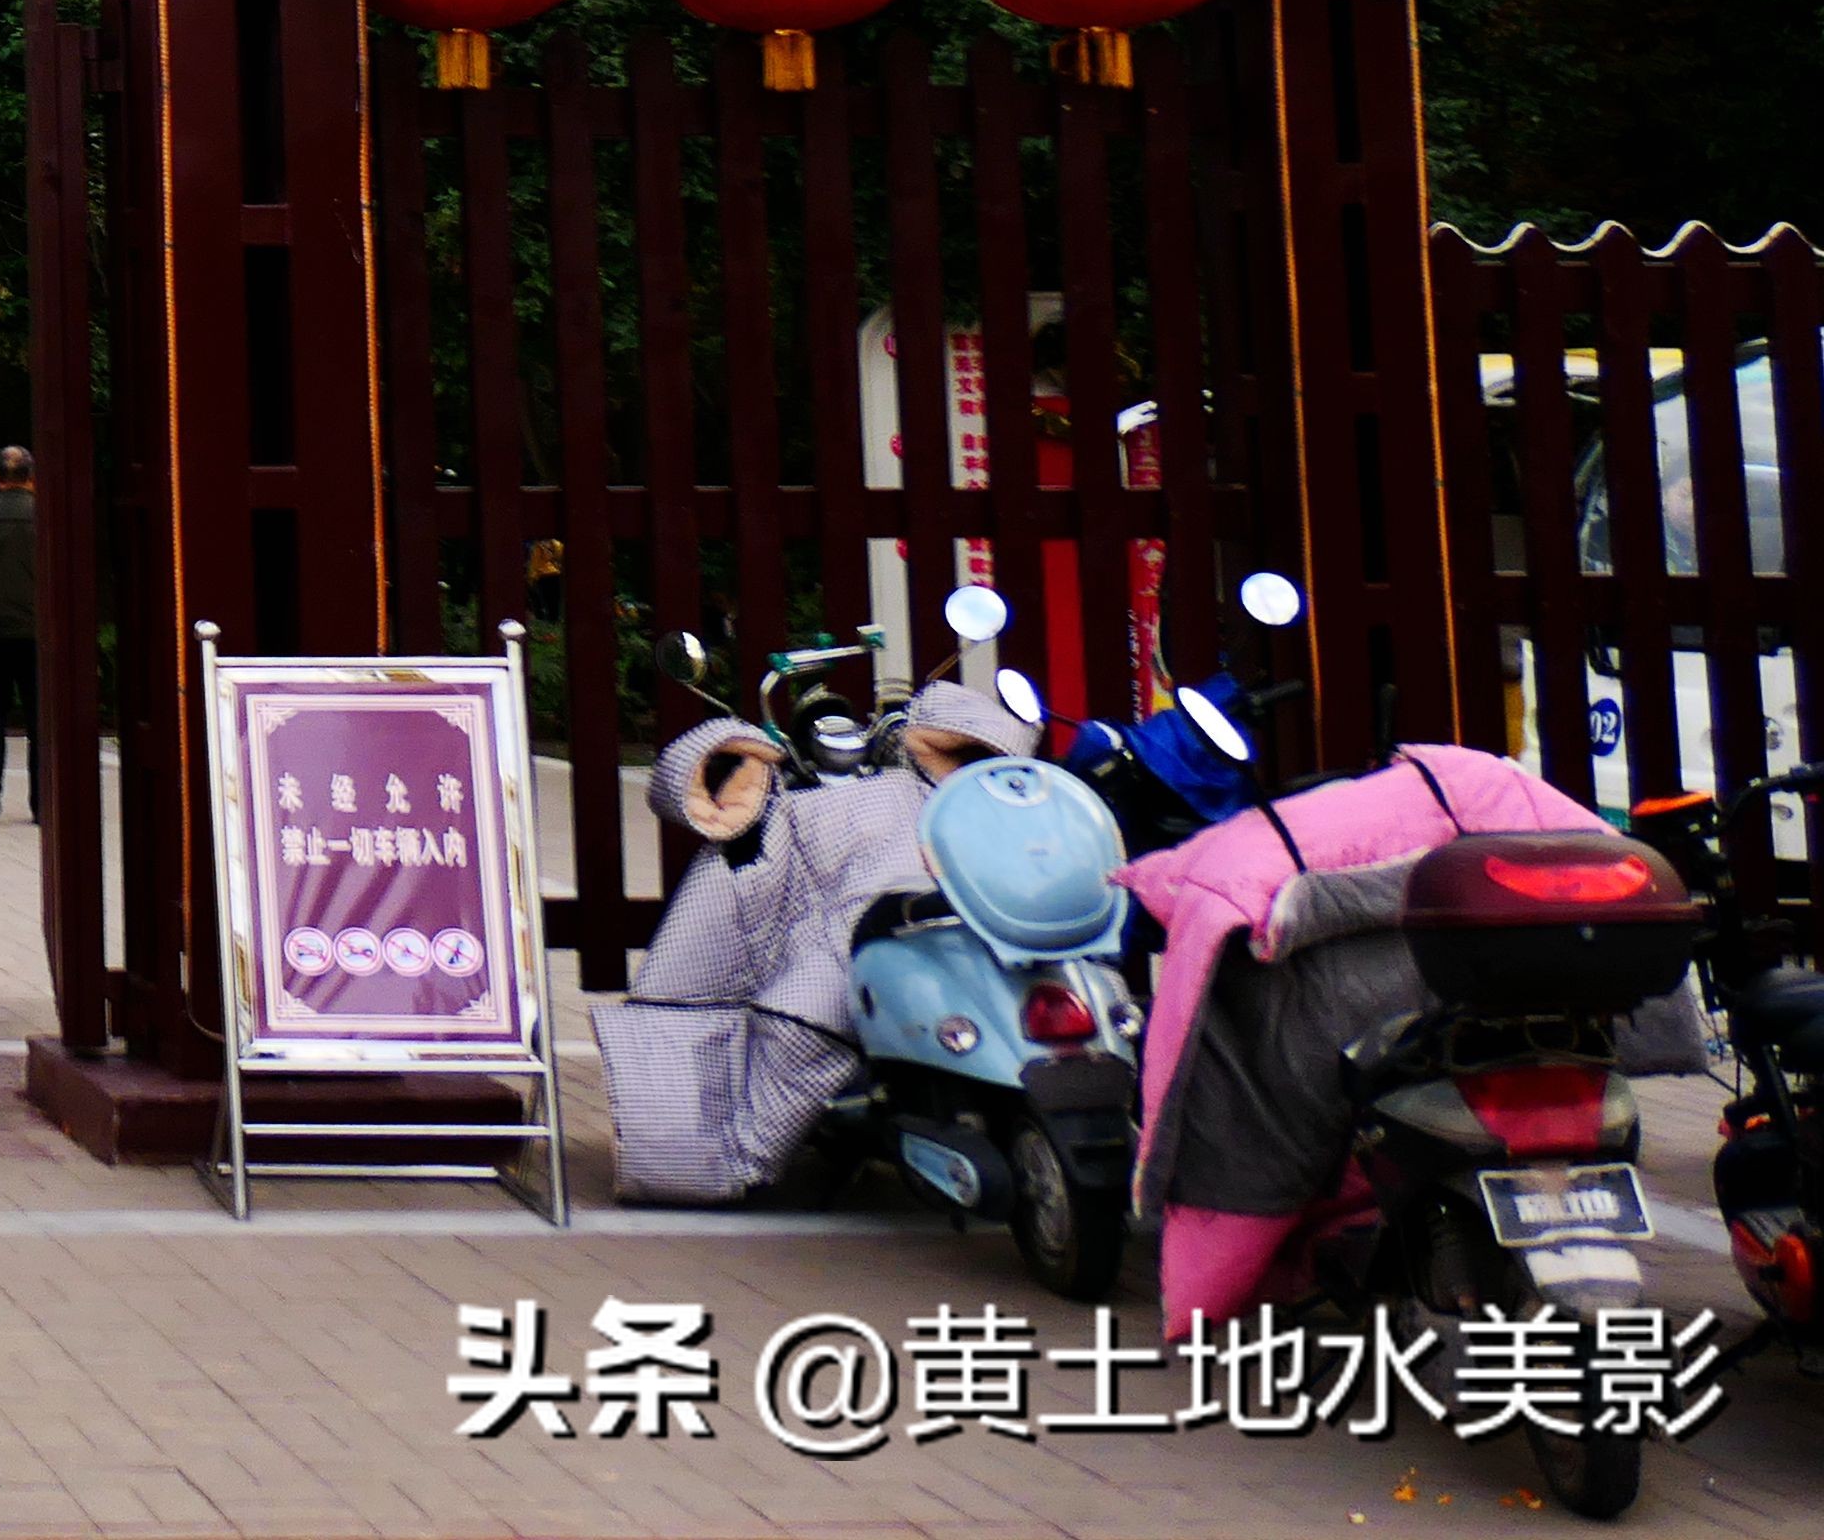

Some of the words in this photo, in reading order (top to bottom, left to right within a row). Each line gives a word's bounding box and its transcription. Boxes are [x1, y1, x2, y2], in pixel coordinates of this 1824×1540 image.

[280, 825, 468, 868] 禁止一切车辆入内
